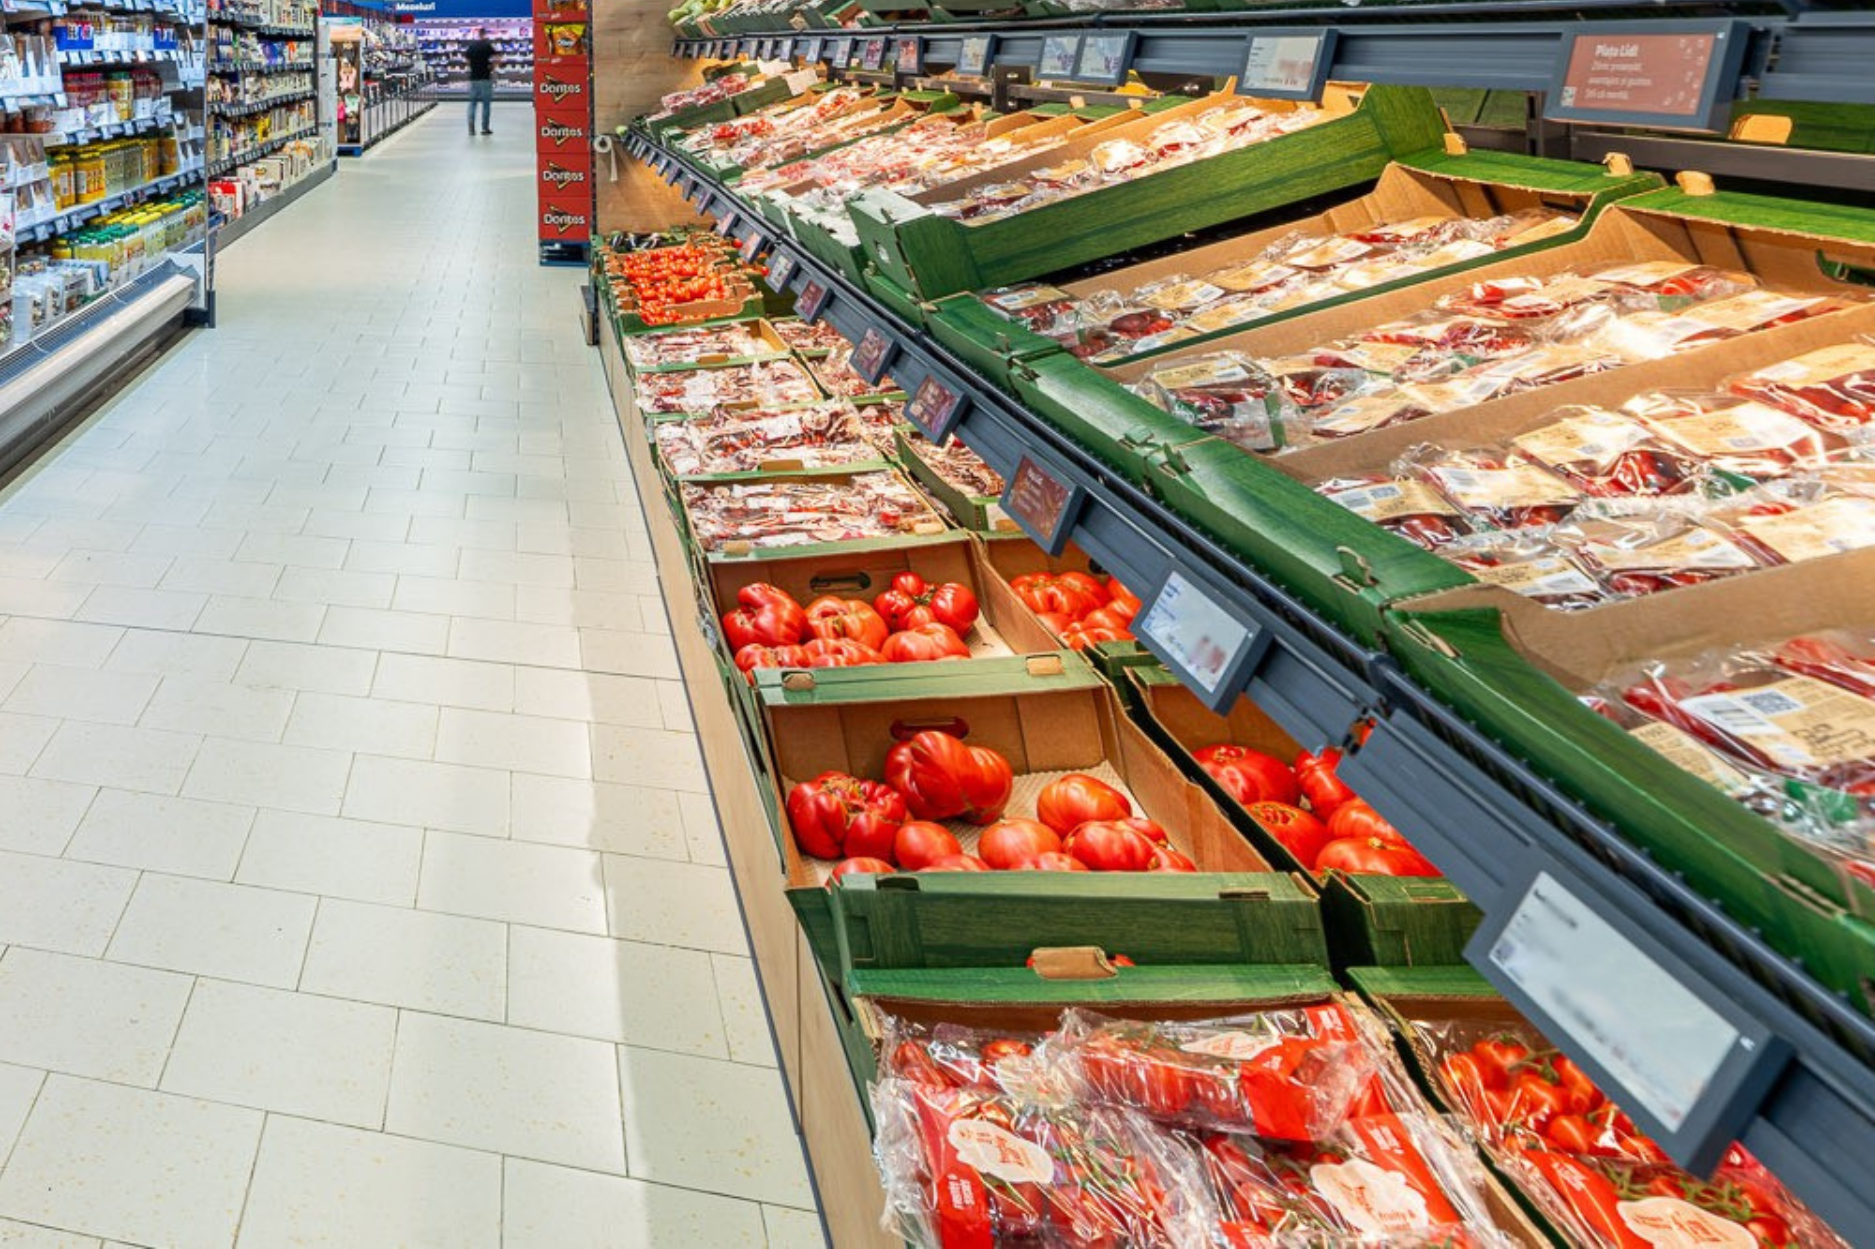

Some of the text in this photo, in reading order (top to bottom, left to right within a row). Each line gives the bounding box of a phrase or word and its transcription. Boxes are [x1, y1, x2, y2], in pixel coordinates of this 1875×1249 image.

[540, 82, 581, 93] Doritos
[541, 126, 582, 138] Doritos
[543, 170, 584, 182] Doritos
[544, 213, 585, 225] Doritos
